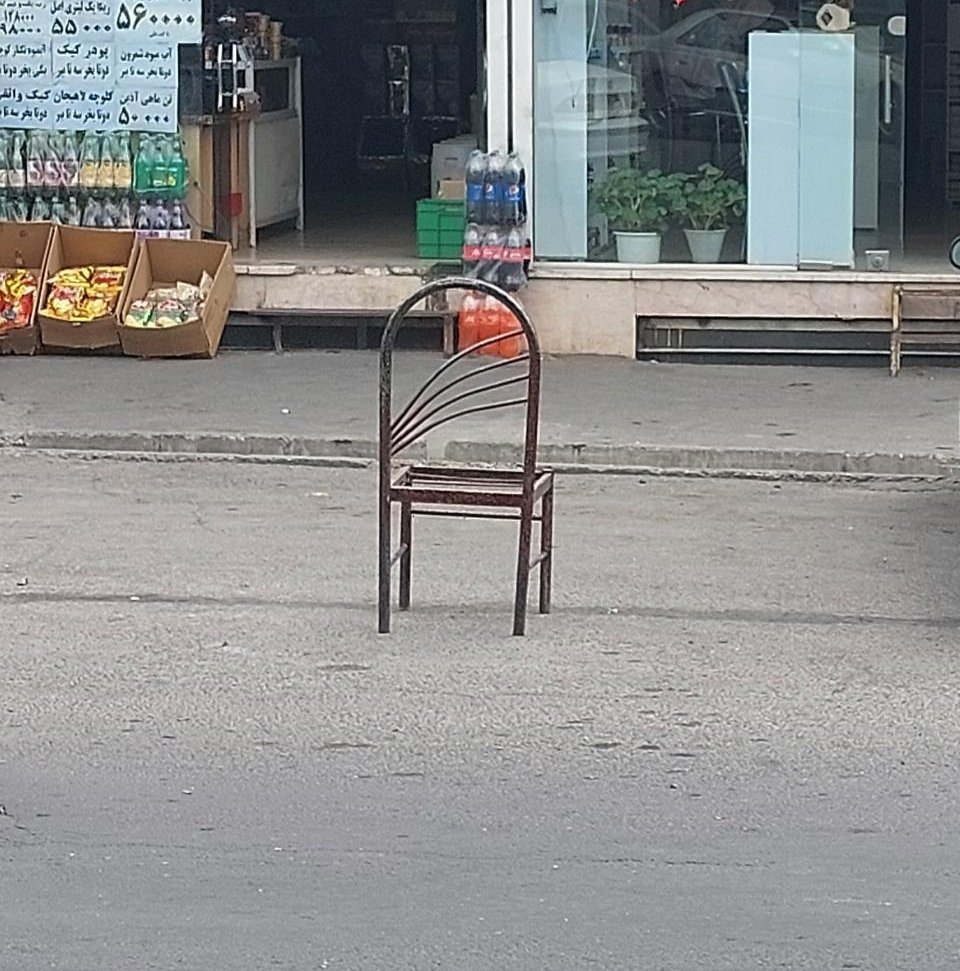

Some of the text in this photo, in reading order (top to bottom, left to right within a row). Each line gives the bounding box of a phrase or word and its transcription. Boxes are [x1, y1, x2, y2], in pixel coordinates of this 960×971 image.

[117, 2, 196, 30] ۵۶۰۰۰۰
[51, 18, 112, 35] ۵۵۰۰۰
[57, 43, 109, 59] پودر کیک
[25, 89, 52, 103] کیک
[53, 89, 114, 105] کلوچه لاهیجان
[118, 106, 170, 125] ۵۰۰۰۰
